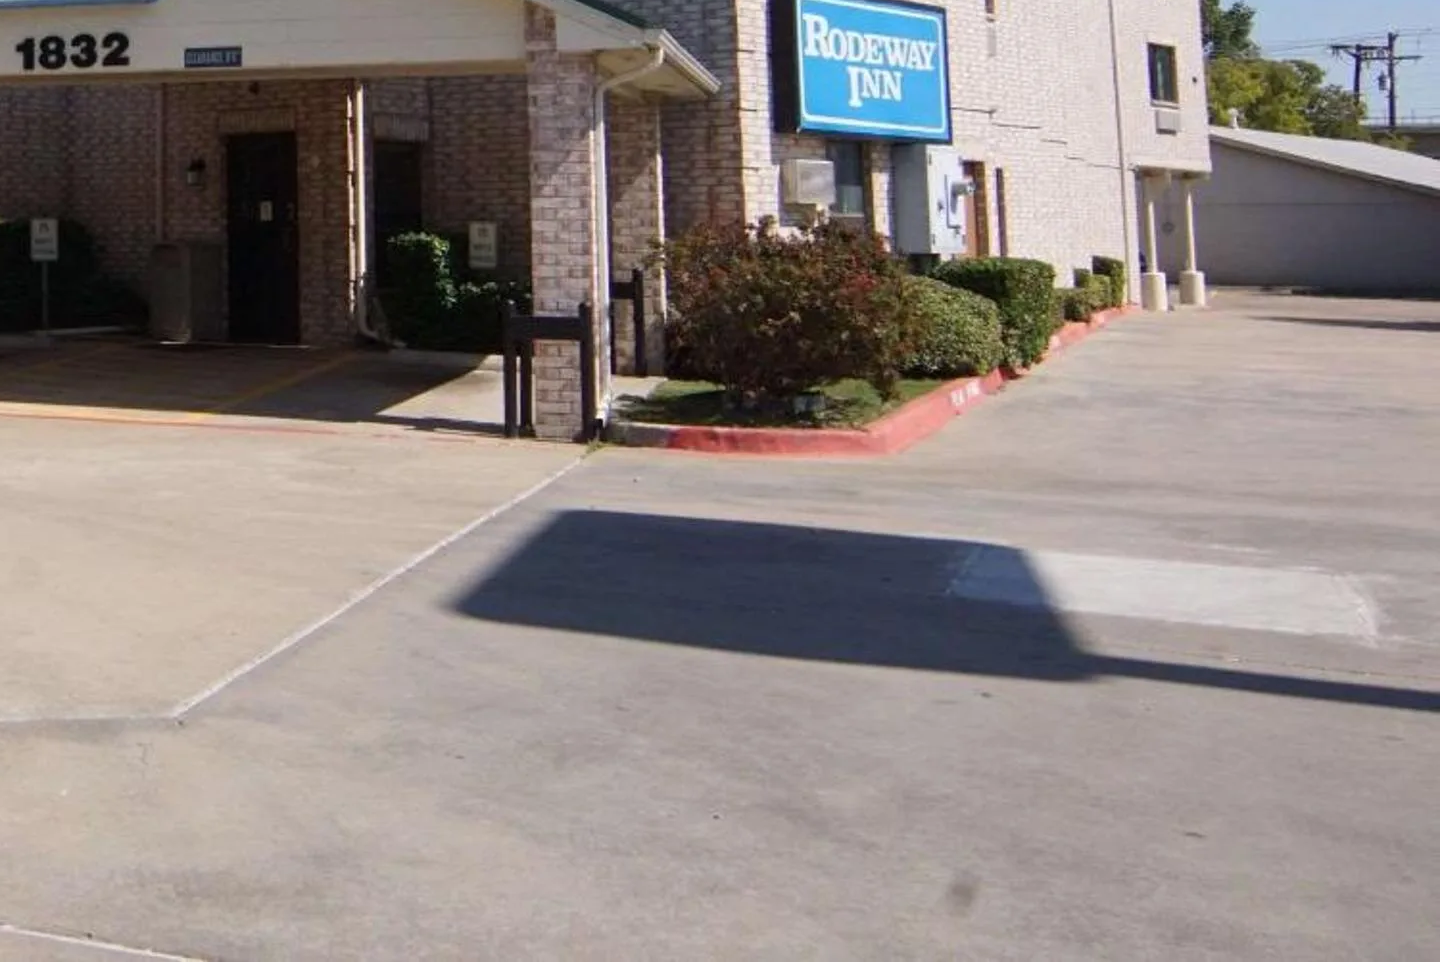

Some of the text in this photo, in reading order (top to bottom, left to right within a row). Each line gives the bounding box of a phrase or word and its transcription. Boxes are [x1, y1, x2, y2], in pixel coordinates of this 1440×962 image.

[15, 32, 130, 70] 1832
[802, 13, 937, 71] RODEWAY
[847, 66, 904, 107] INN
